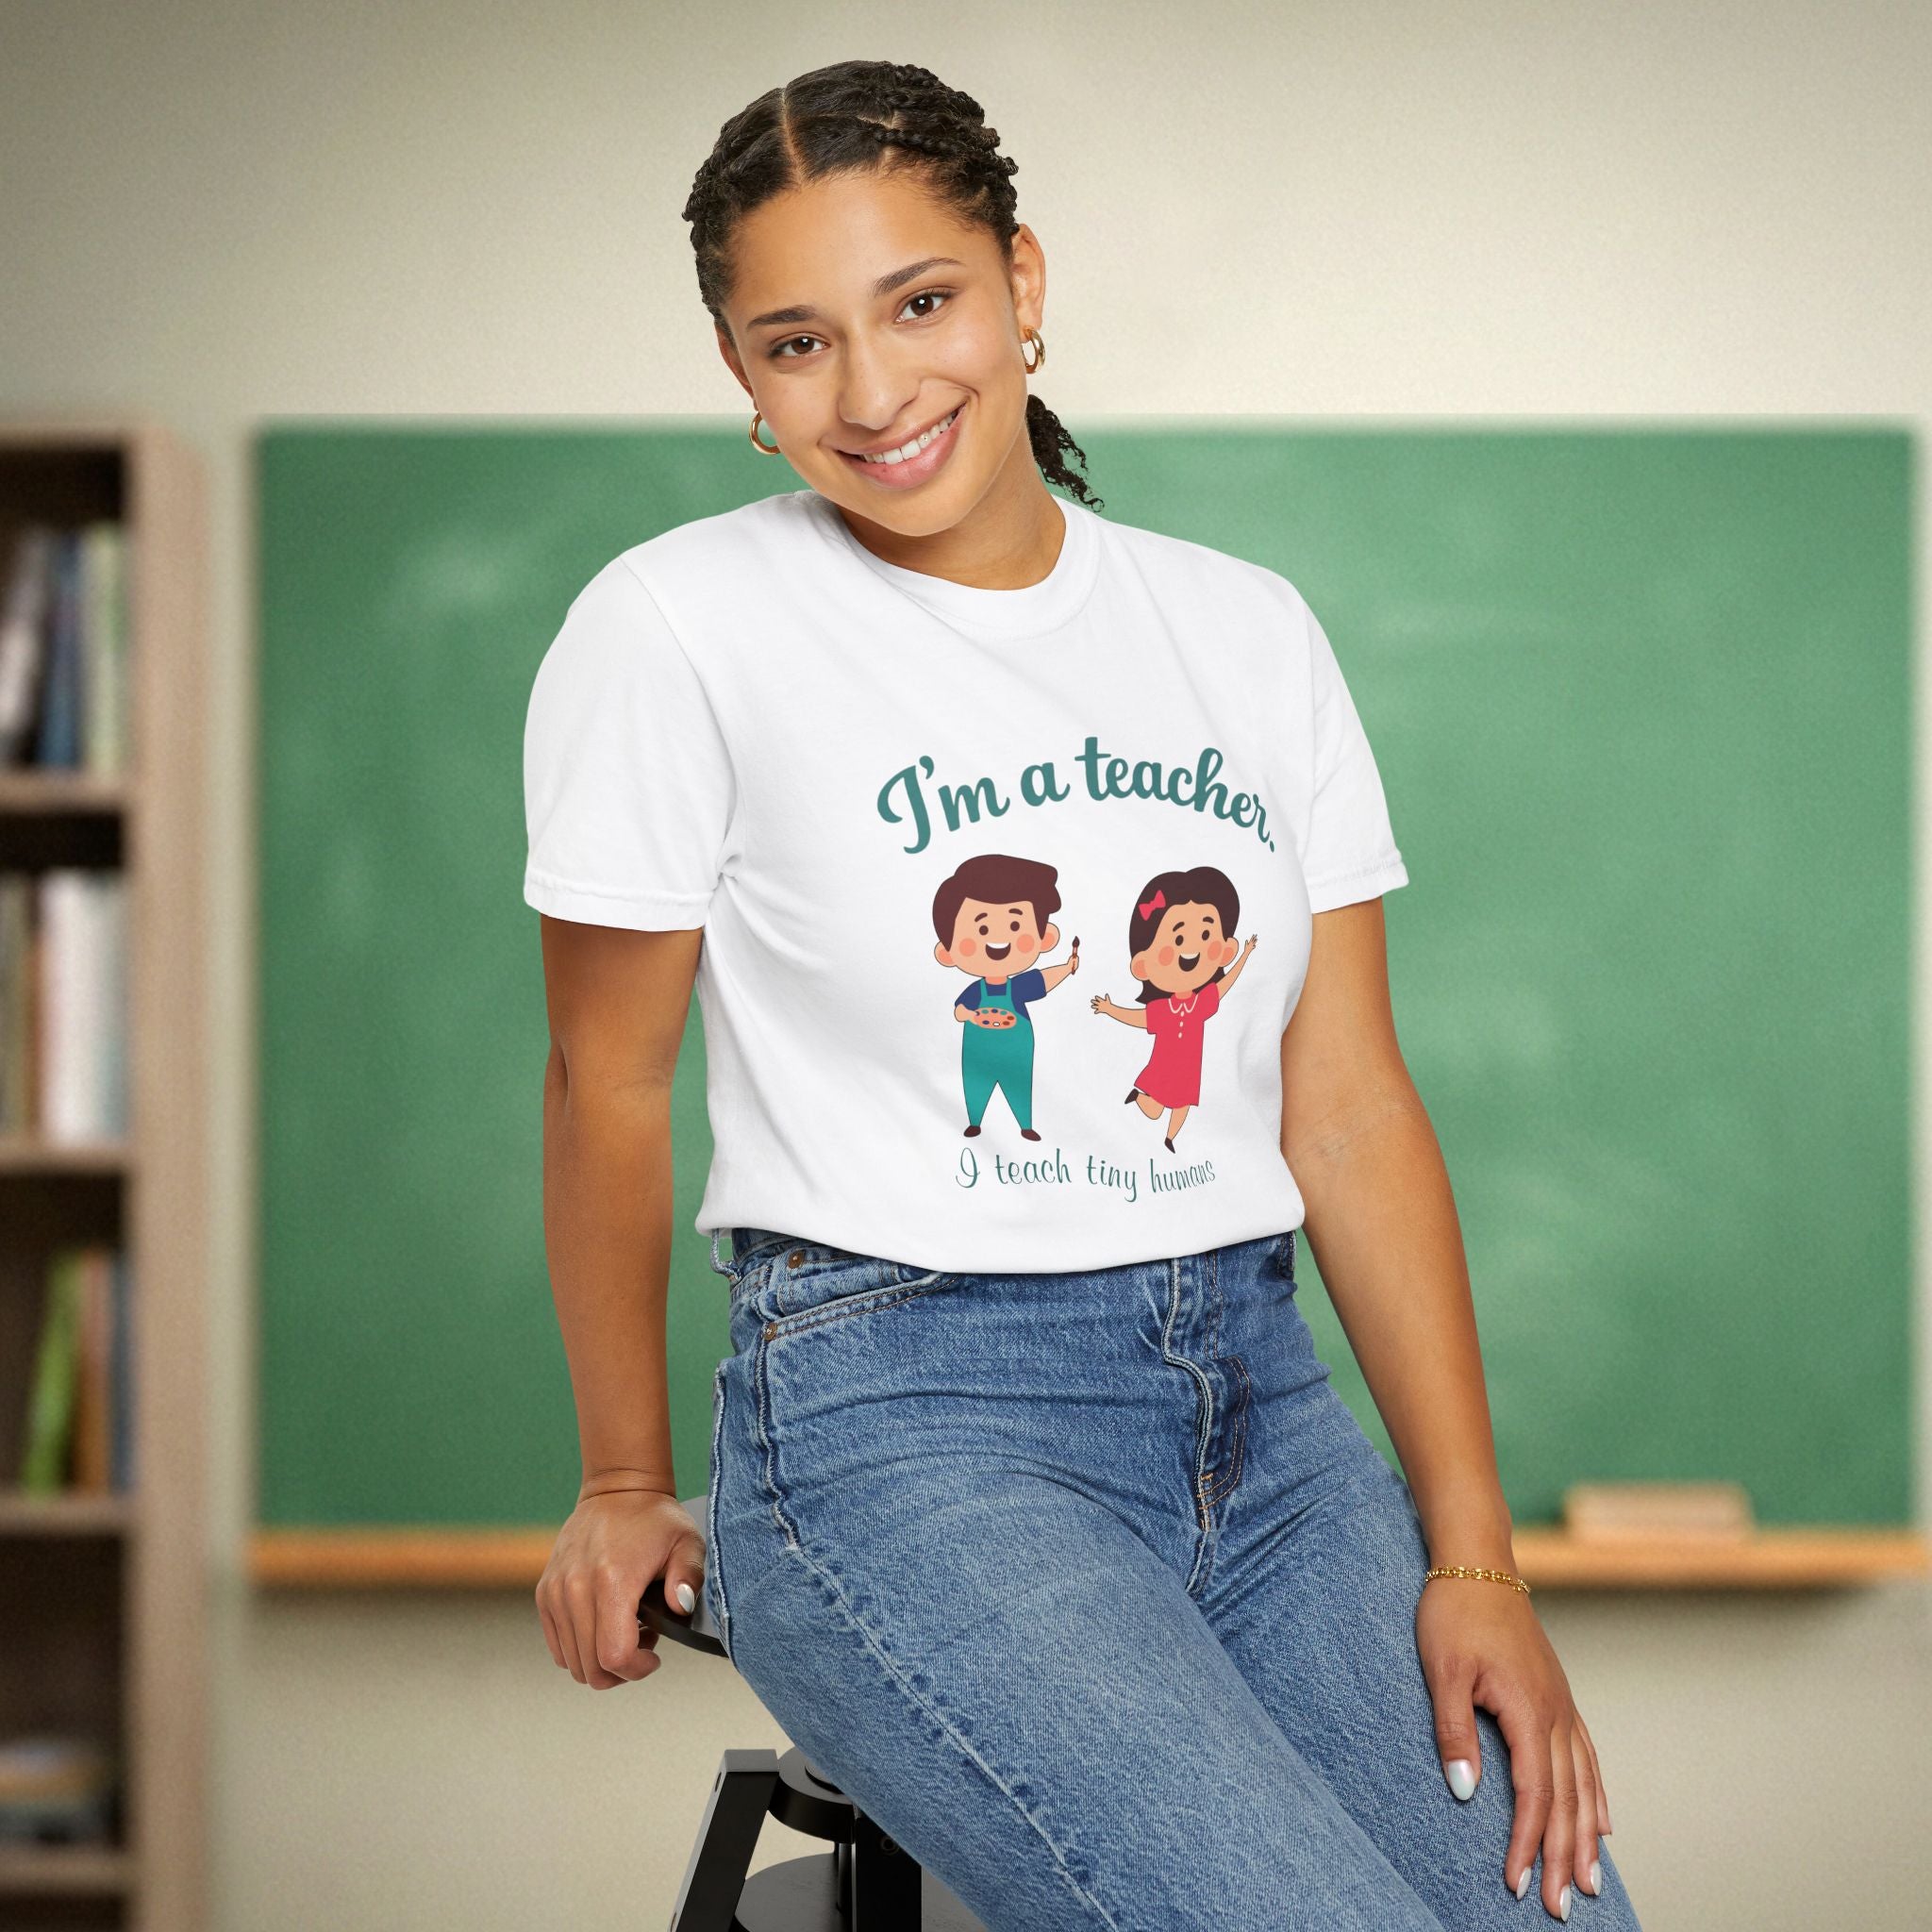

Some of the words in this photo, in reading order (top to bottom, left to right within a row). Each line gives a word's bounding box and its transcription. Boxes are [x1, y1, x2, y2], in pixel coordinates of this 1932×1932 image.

[877, 756, 1010, 855] I'm
[1021, 762, 1070, 807] a
[1074, 737, 1275, 853] teacher.
[956, 1147, 980, 1189] I
[995, 1148, 1072, 1184] teach
[1087, 1155, 1137, 1203] tiny
[1150, 1158, 1216, 1193] humans
